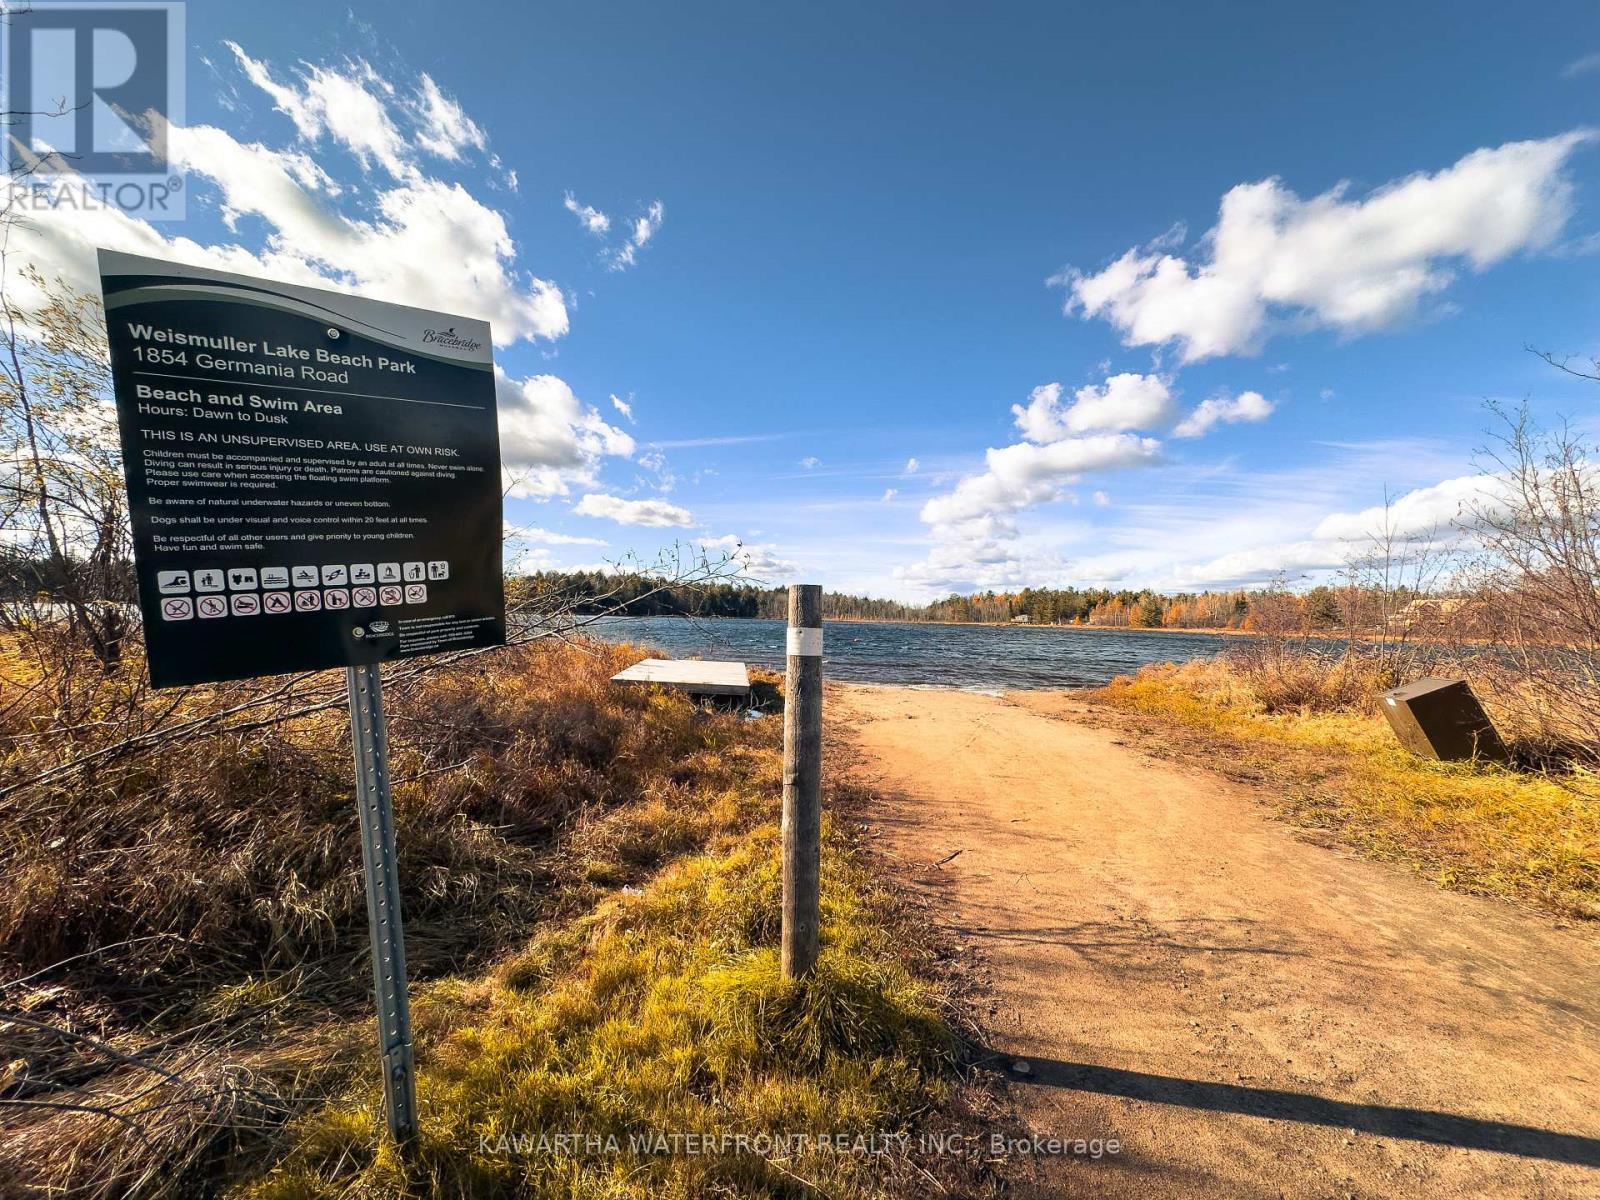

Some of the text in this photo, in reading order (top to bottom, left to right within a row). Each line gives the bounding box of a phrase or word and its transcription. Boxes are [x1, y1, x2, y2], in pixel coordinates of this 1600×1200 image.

[127, 322, 417, 374] Weismuller Lake Beach Park
[422, 328, 482, 352] Bracebridge
[133, 346, 349, 384] 1854 Germania Road
[136, 384, 343, 415] Beach and Swim Area
[138, 402, 289, 425] Hours: Dawn to Dusk
[140, 429, 460, 457] THIS IS AN UNSUPERVISED AREA. USE AT OWN RISK.
[143, 449, 184, 458] Children
[186, 451, 210, 460] must
[211, 452, 224, 460] be
[225, 454, 284, 463] accompanied
[303, 457, 345, 466] supervised
[346, 459, 356, 467] by
[369, 460, 387, 468] adult
[428, 463, 447, 471] Never
[144, 459, 175, 469] Diving
[197, 461, 223, 469] result
[235, 463, 267, 471] serious
[269, 464, 292, 473] injury
[331, 466, 360, 474] Patrons
[375, 469, 410, 477] cautioned
[145, 468, 179, 477] Please
[223, 471, 248, 479] when
[250, 473, 292, 482] accessing
[293, 473, 307, 481] the
[309, 474, 338, 483] floating
[146, 477, 278, 489] Proper swimwear is required.
[148, 496, 163, 505] Be
[196, 497, 206, 505] of
[208, 498, 239, 506] natural
[241, 498, 289, 506] underwater
[290, 499, 323, 507] hazards
[334, 500, 362, 508] uneven
[150, 516, 177, 525] Dogs
[179, 516, 201, 524] shall
[203, 516, 215, 524] be
[217, 516, 243, 524] under
[245, 516, 270, 524] visual
[272, 516, 288, 524] and
[290, 516, 312, 524] voice
[313, 516, 340, 524] control
[341, 516, 363, 524] within
[364, 516, 375, 524] 20
[375, 516, 390, 524] feet
[391, 516, 398, 524] at
[153, 535, 167, 543] Be
[169, 534, 215, 544] respectful
[240, 533, 263, 541] other
[290, 533, 306, 541] and
[307, 533, 324, 542] give
[325, 533, 352, 542] priority
[353, 532, 361, 540] to
[362, 533, 385, 541] young
[154, 542, 265, 552] Have fun and swim safe.
